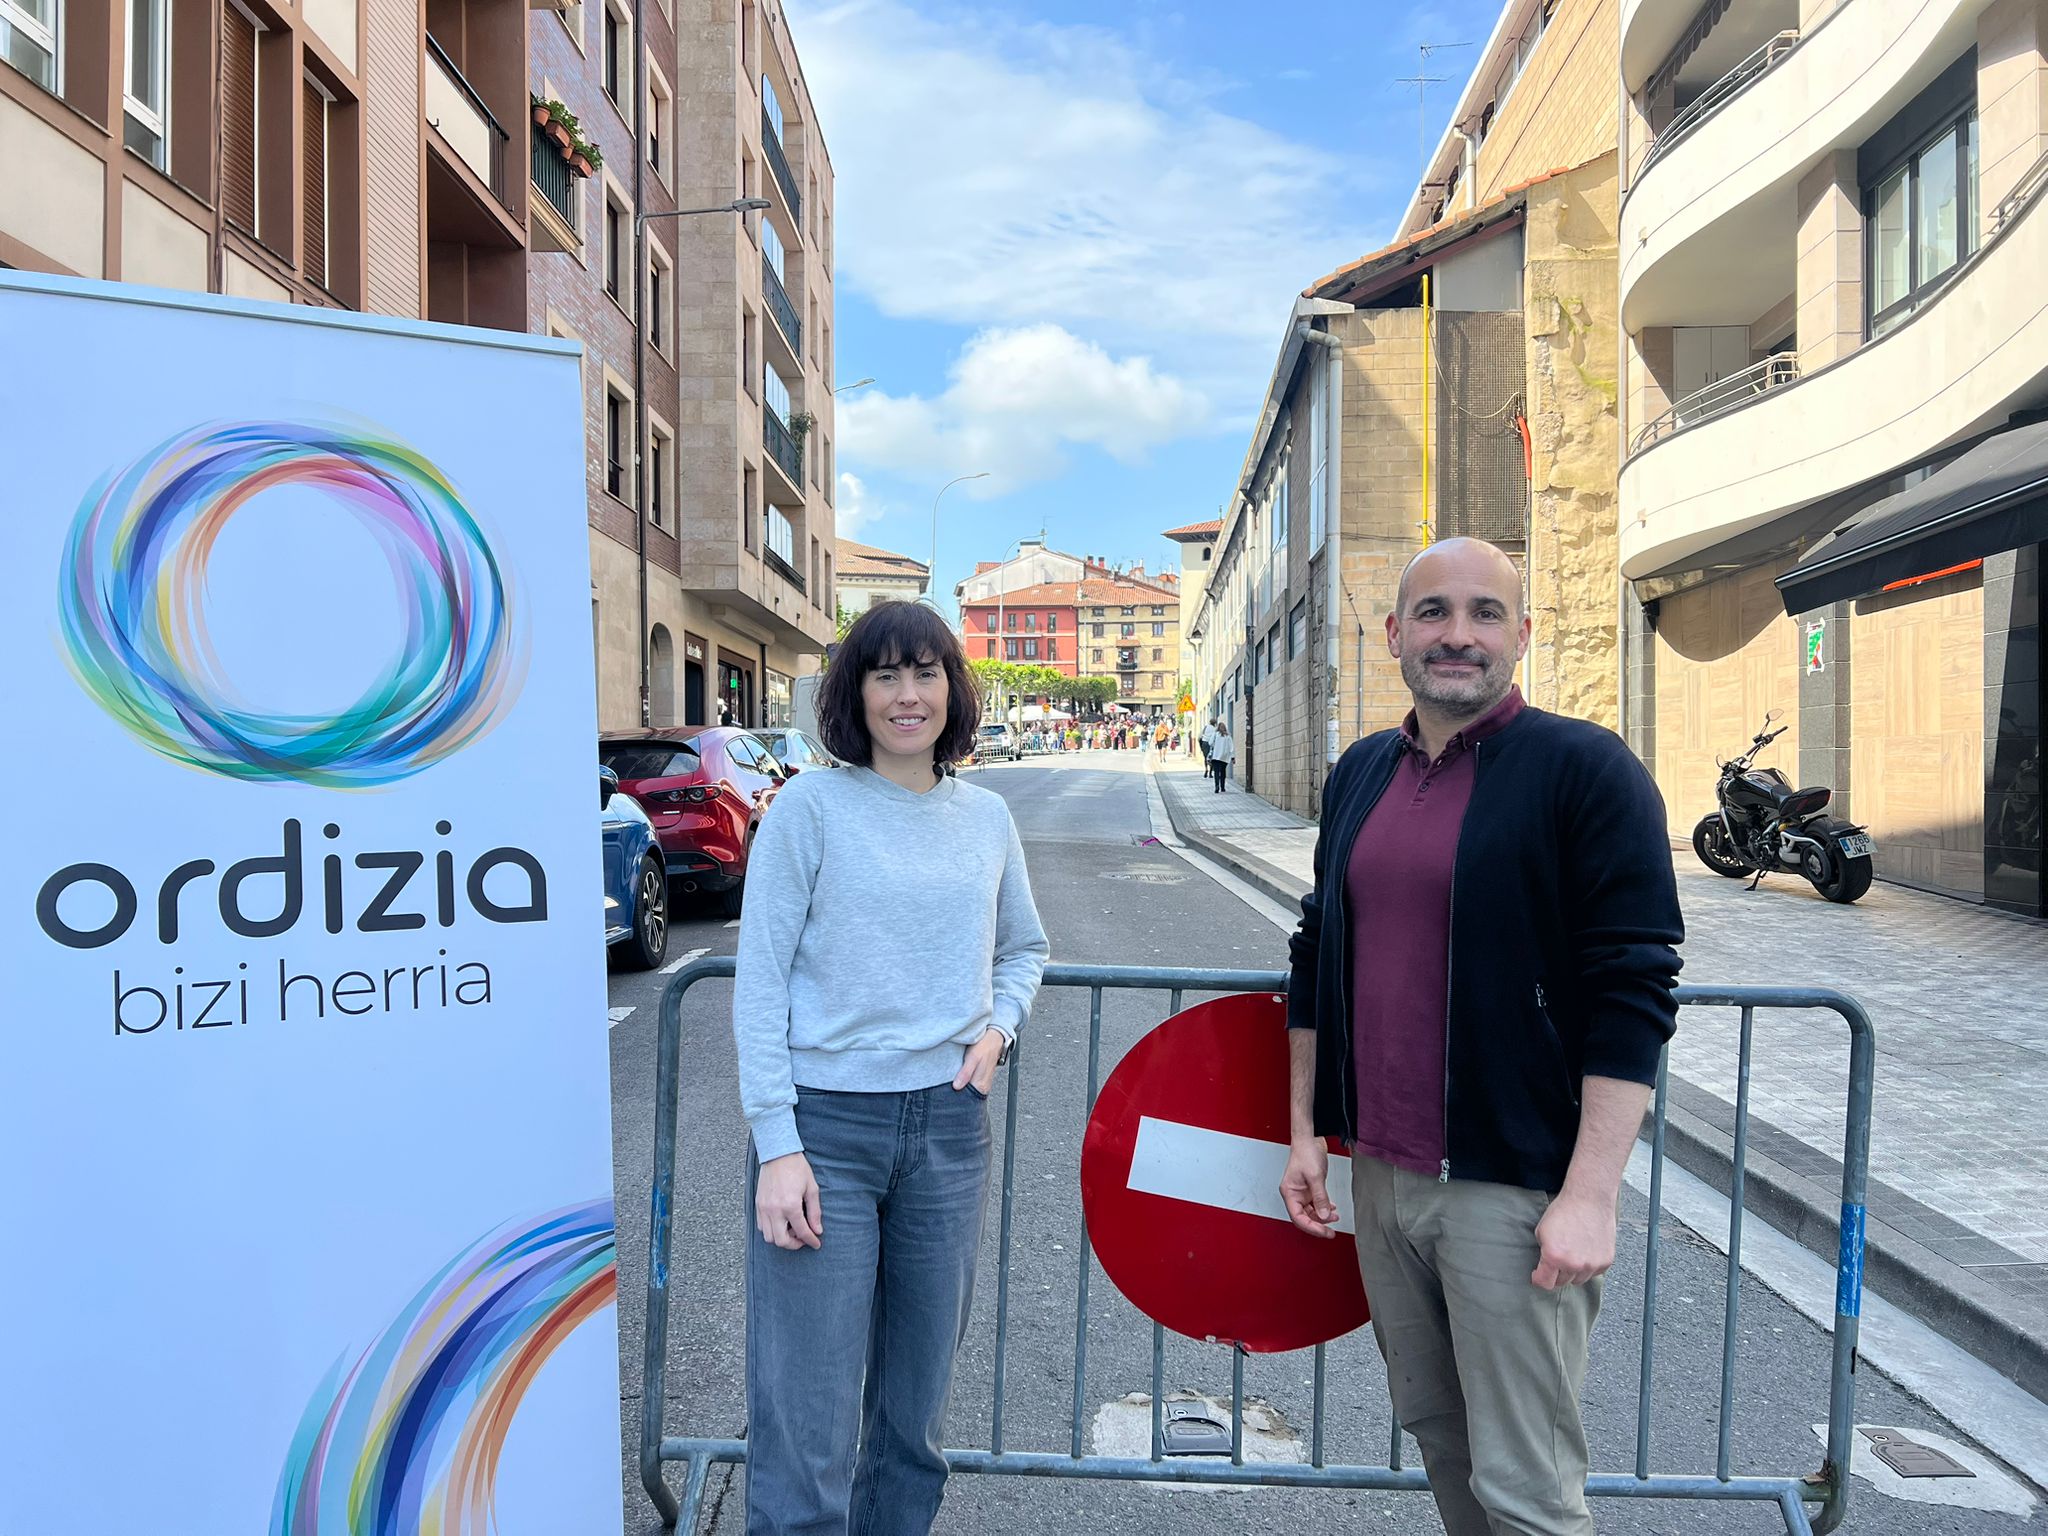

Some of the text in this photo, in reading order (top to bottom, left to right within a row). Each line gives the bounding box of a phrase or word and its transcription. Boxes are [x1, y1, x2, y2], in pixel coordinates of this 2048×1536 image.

[36, 818, 548, 949] ordizia
[114, 948, 492, 1036] bizi herria
